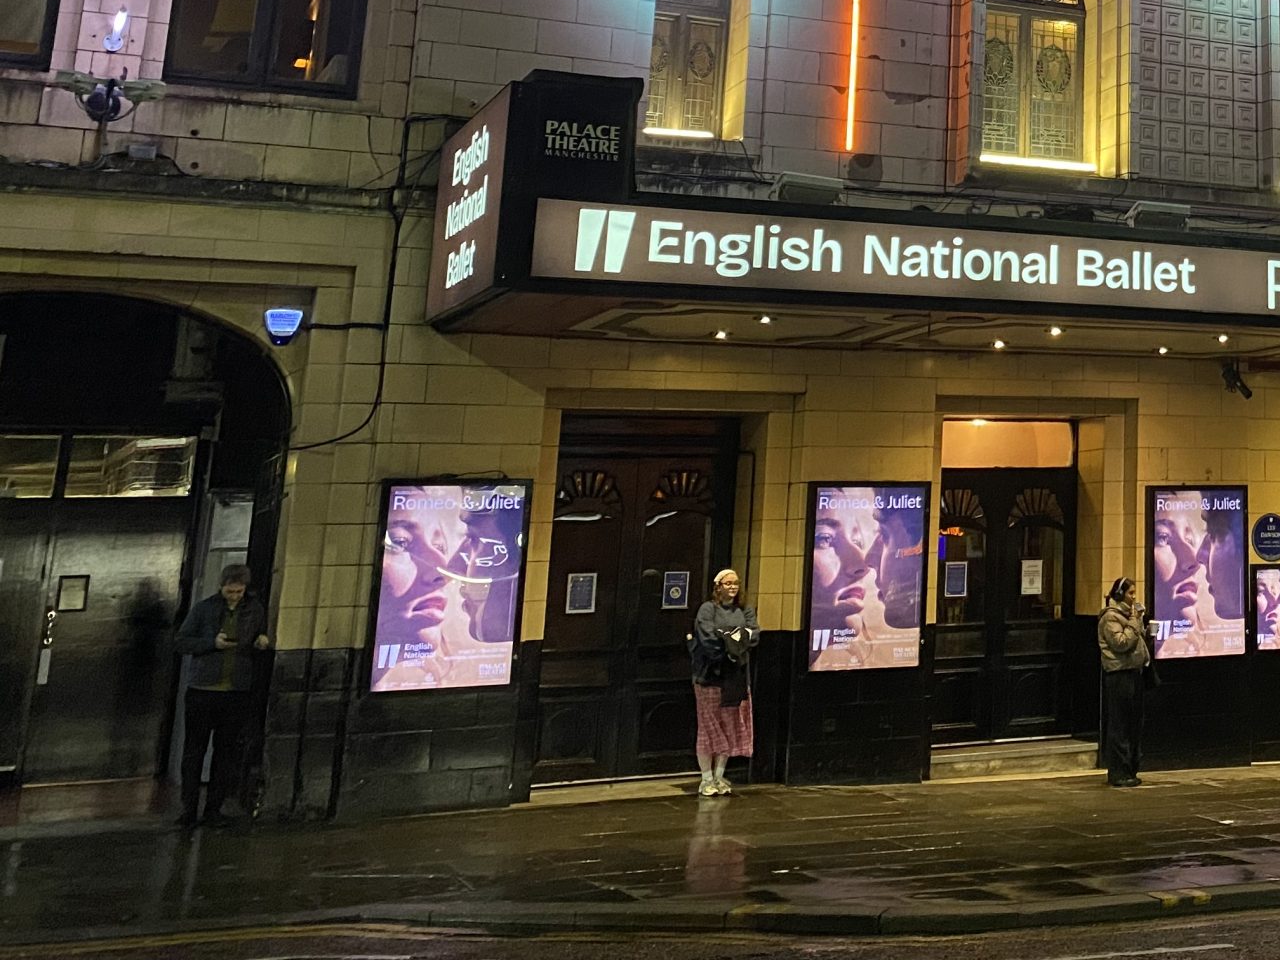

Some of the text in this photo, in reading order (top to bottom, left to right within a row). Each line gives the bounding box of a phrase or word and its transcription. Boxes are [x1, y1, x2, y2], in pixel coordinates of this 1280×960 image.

[546, 120, 621, 140] PALACE
[545, 134, 620, 154] THEATRE
[452, 125, 489, 187] English
[545, 148, 619, 161] MANCHESTER
[445, 174, 488, 240] National
[445, 240, 476, 289] Ballet
[649, 221, 842, 278] English
[863, 234, 1059, 285] National
[1076, 248, 1197, 294] Ballet
[393, 494, 520, 510] Romeo & Juliet
[819, 495, 922, 509] Romeo & Juliet
[1157, 497, 1240, 511] Romeo & Juliet
[404, 642, 433, 651] English
